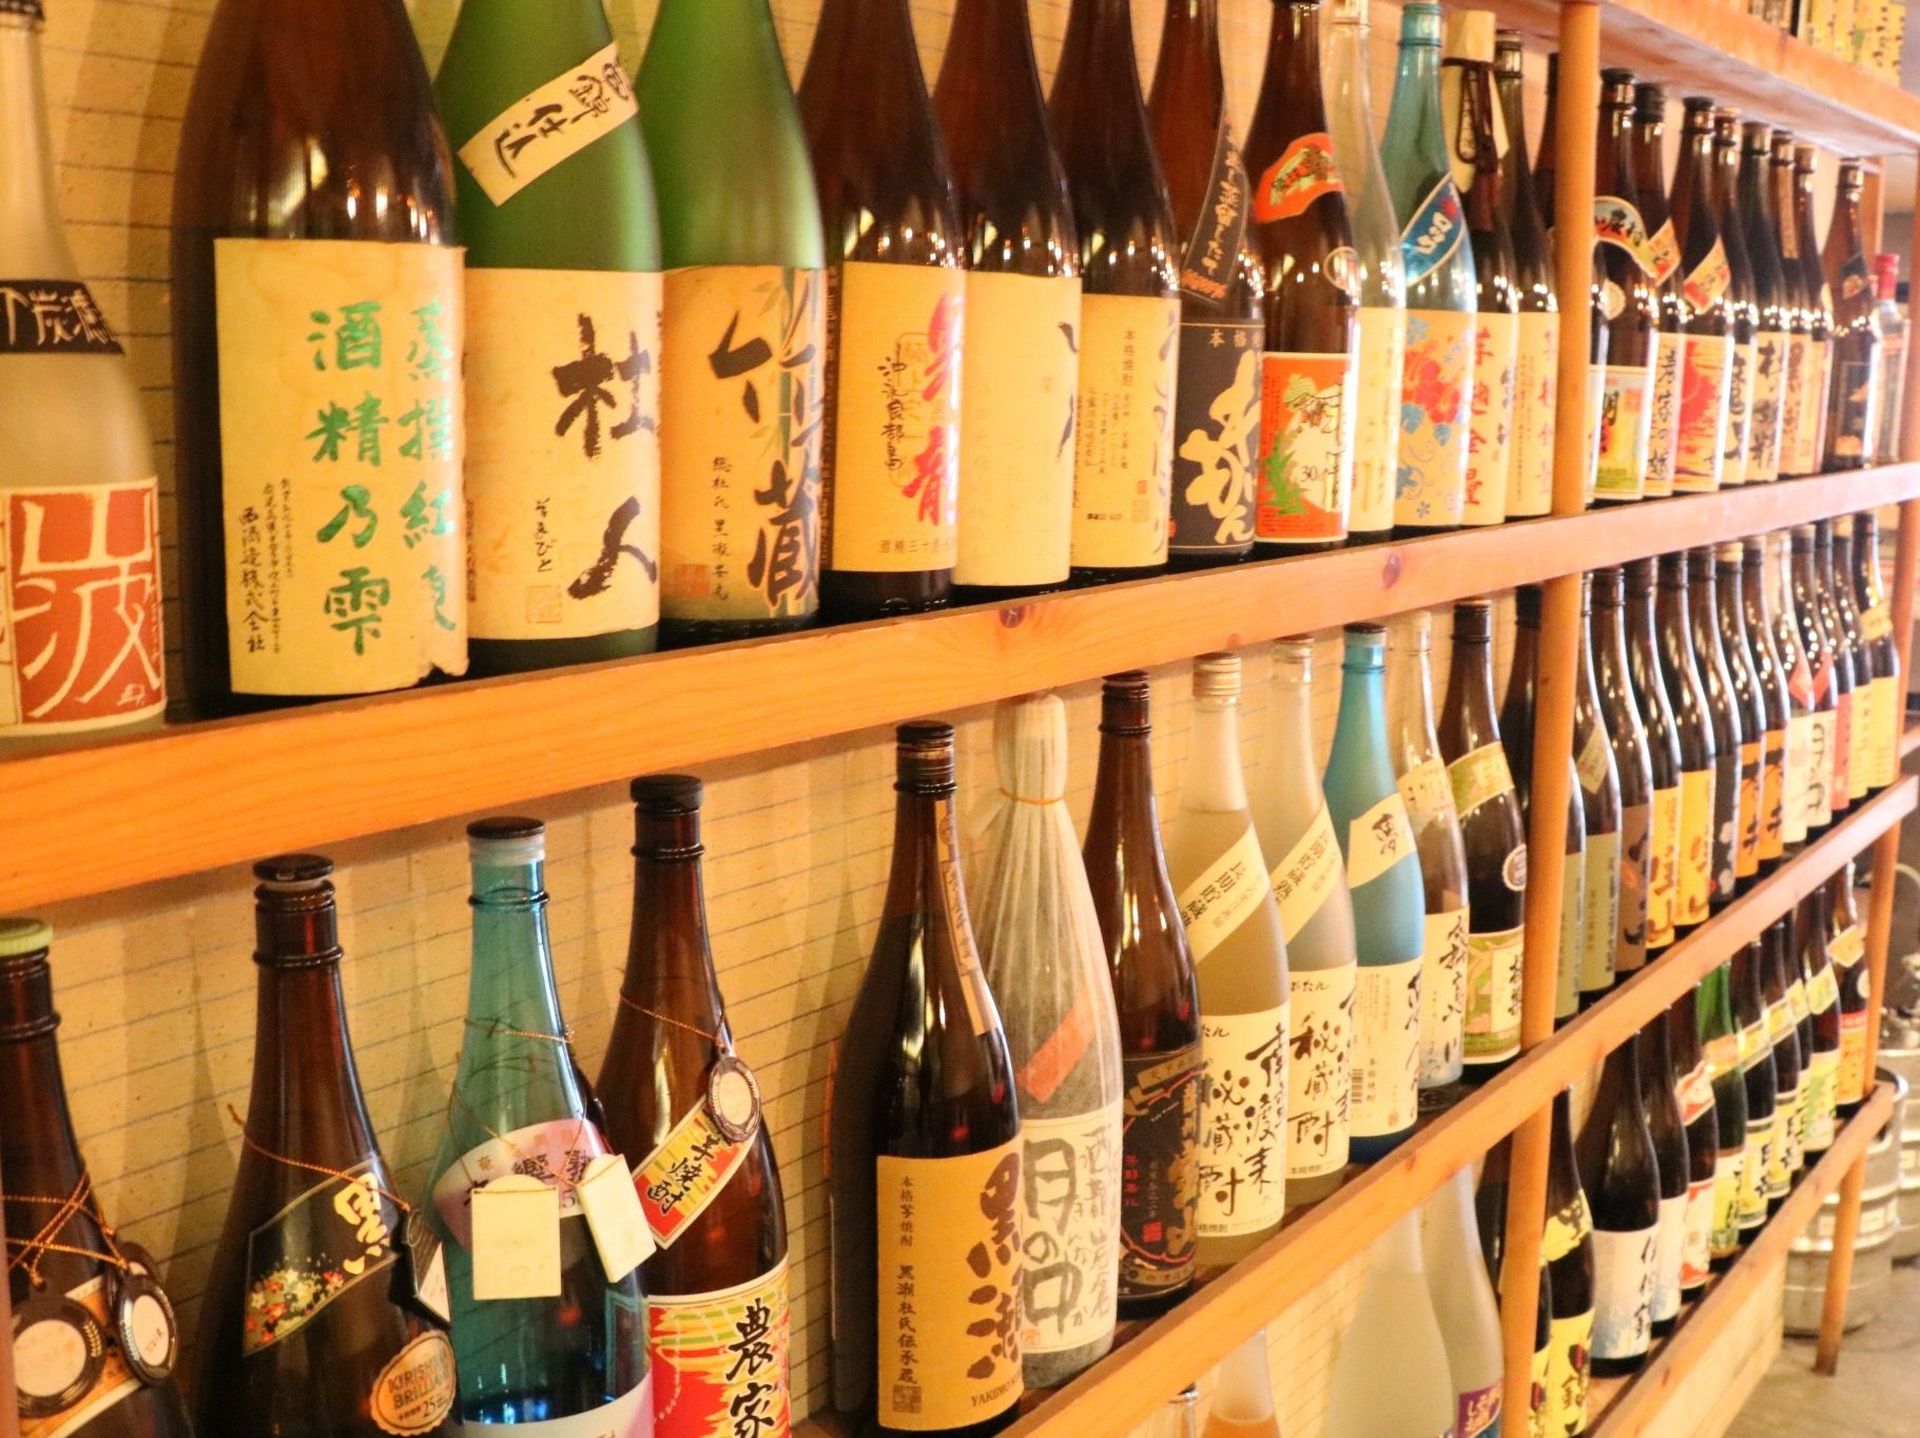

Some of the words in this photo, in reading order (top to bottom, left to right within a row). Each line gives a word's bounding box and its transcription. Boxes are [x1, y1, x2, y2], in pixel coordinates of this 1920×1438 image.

[305, 300, 390, 656] 酒精乃雫
[646, 1134, 722, 1215] 芋焼酎
